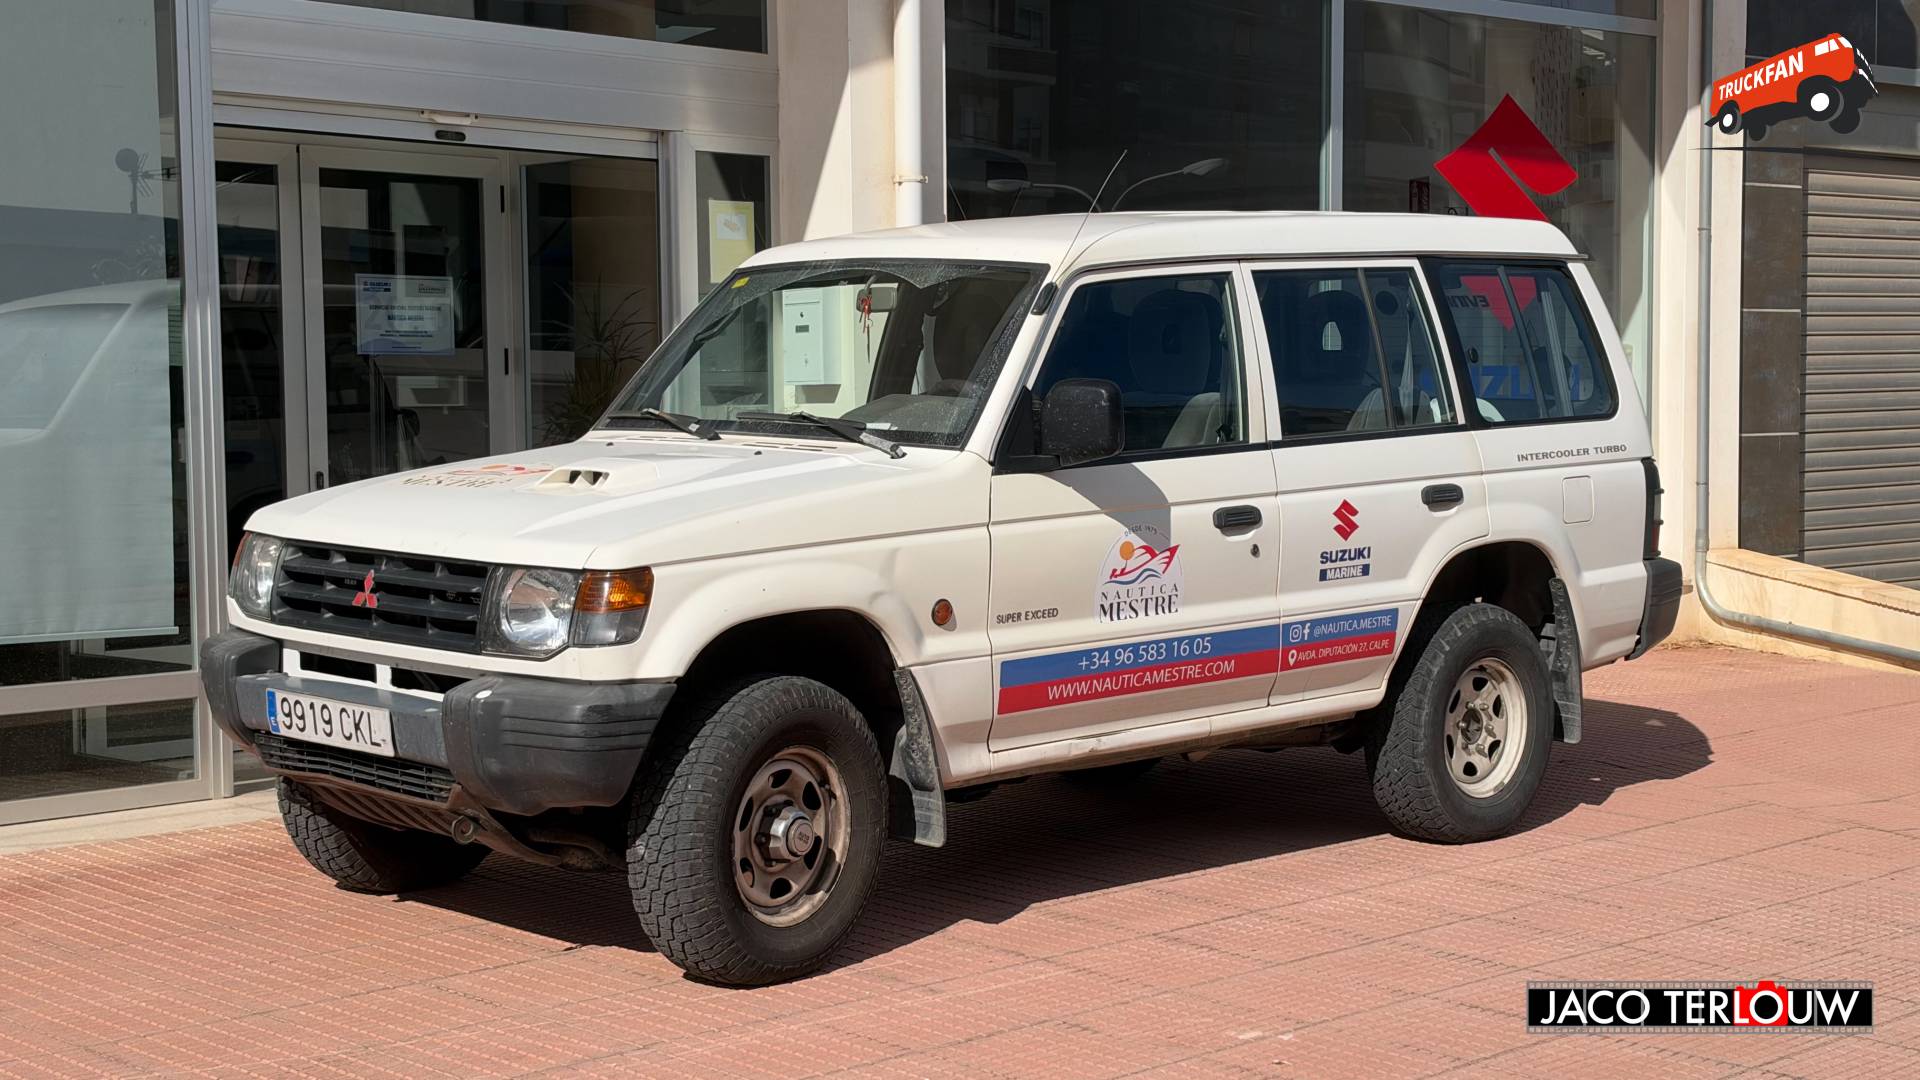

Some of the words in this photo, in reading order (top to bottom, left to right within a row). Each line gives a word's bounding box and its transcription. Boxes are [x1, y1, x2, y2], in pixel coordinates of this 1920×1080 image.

[1517, 447, 1590, 462] INTERCOOLER
[1593, 444, 1627, 455] TURBO
[1320, 546, 1371, 564] SUZUKI
[1326, 565, 1363, 580] MARINE
[1101, 583, 1179, 601] NAUTICA
[996, 611, 1022, 624] SUPER
[1025, 608, 1059, 620] EXCEED
[1100, 594, 1179, 623] MESTRE
[1313, 615, 1392, 638] @NAUTICA.MESTRE
[1369, 639, 1390, 650] CALPE
[1078, 651, 1110, 671] +34
[1115, 648, 1134, 666] 96
[1138, 643, 1166, 662] 583
[1172, 640, 1189, 658] 16
[1193, 637, 1212, 655] 05
[1048, 660, 1235, 700] WWW.NAUTICAMESTRE.COM
[281, 697, 333, 737] 9919
[340, 707, 382, 747] CKL
